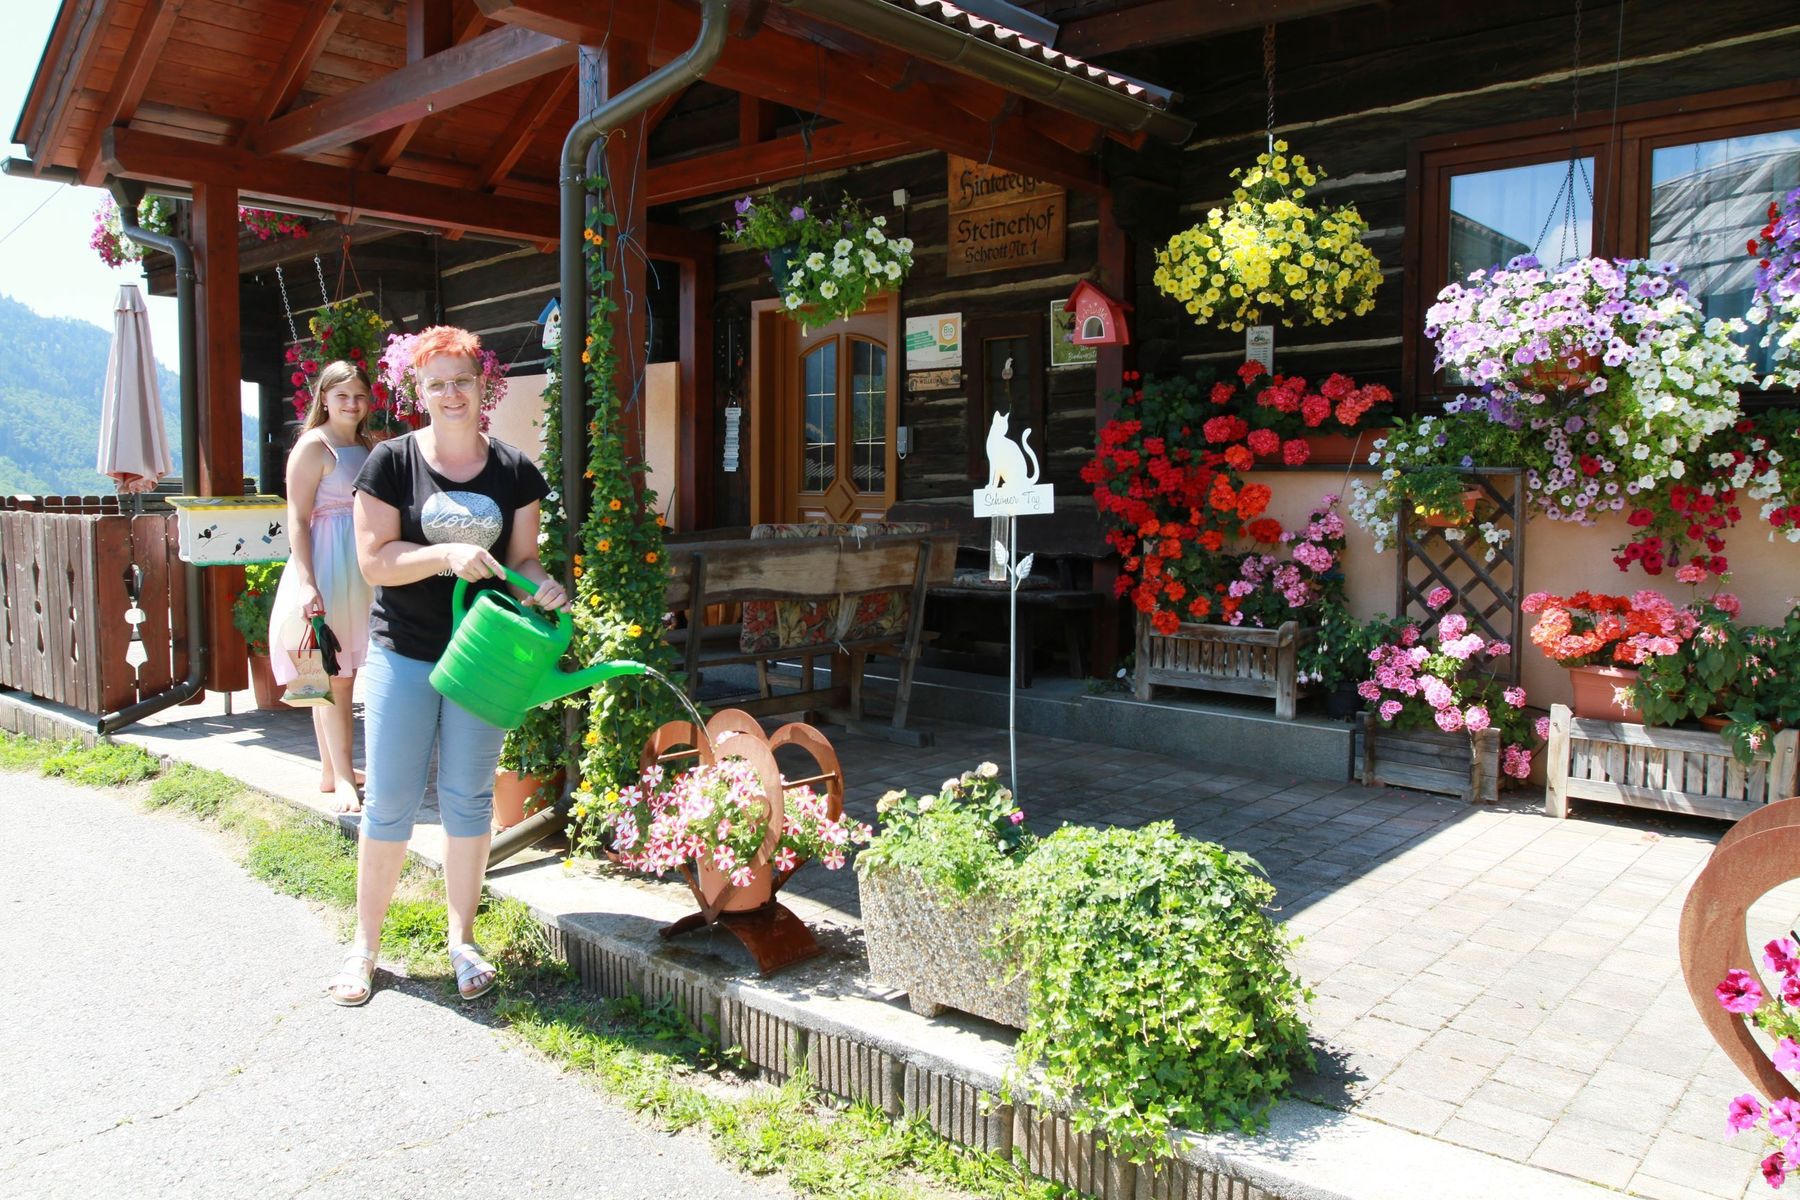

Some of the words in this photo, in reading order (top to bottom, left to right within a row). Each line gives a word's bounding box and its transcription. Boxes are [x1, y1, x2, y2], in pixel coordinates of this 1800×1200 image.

[958, 204, 1055, 243] Steinerhof
[965, 242, 1008, 264] Schrott
[1009, 239, 1029, 259] Nr.
[1032, 239, 1038, 255] 1
[1022, 490, 1041, 510] Tag
